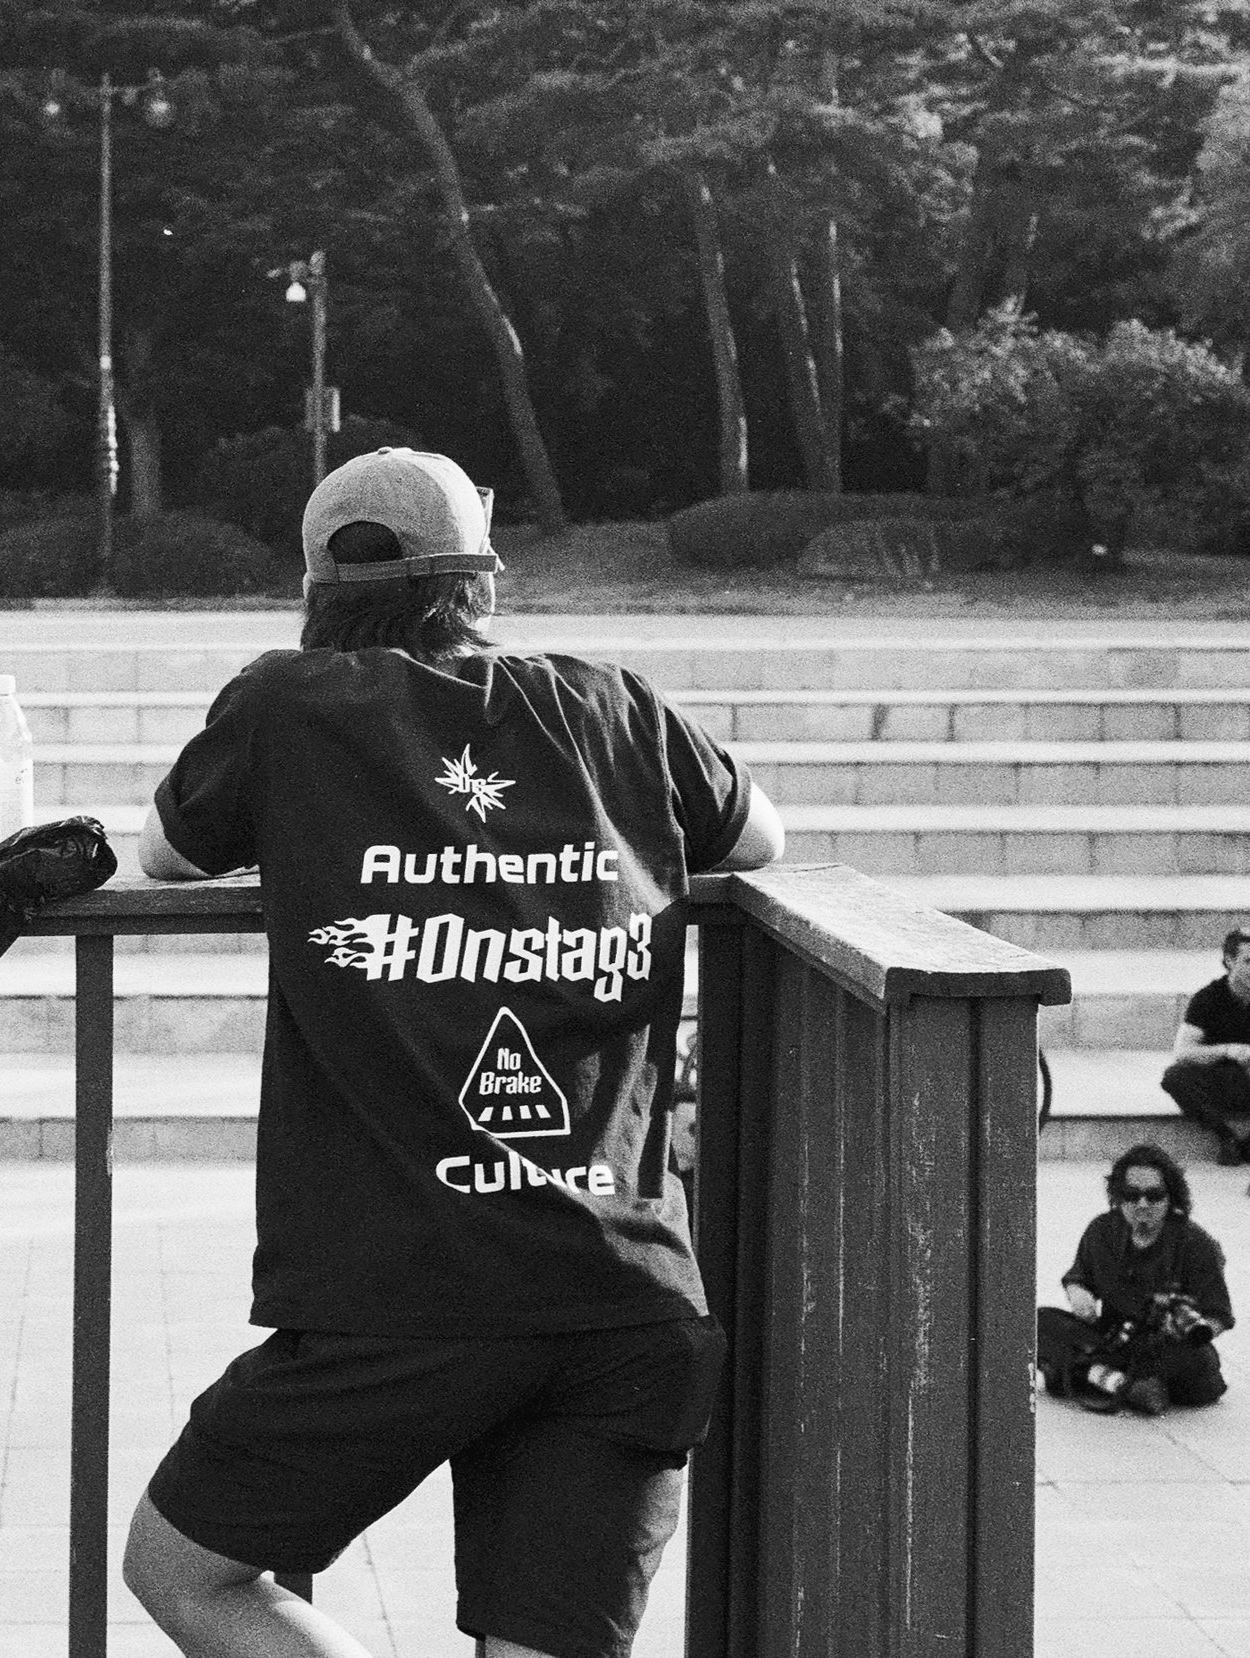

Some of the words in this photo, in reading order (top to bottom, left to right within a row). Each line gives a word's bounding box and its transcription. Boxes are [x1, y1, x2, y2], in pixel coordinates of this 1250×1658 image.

[360, 841, 618, 884] Authentic
[497, 1048, 521, 1070] No
[479, 1071, 542, 1096] Brake
